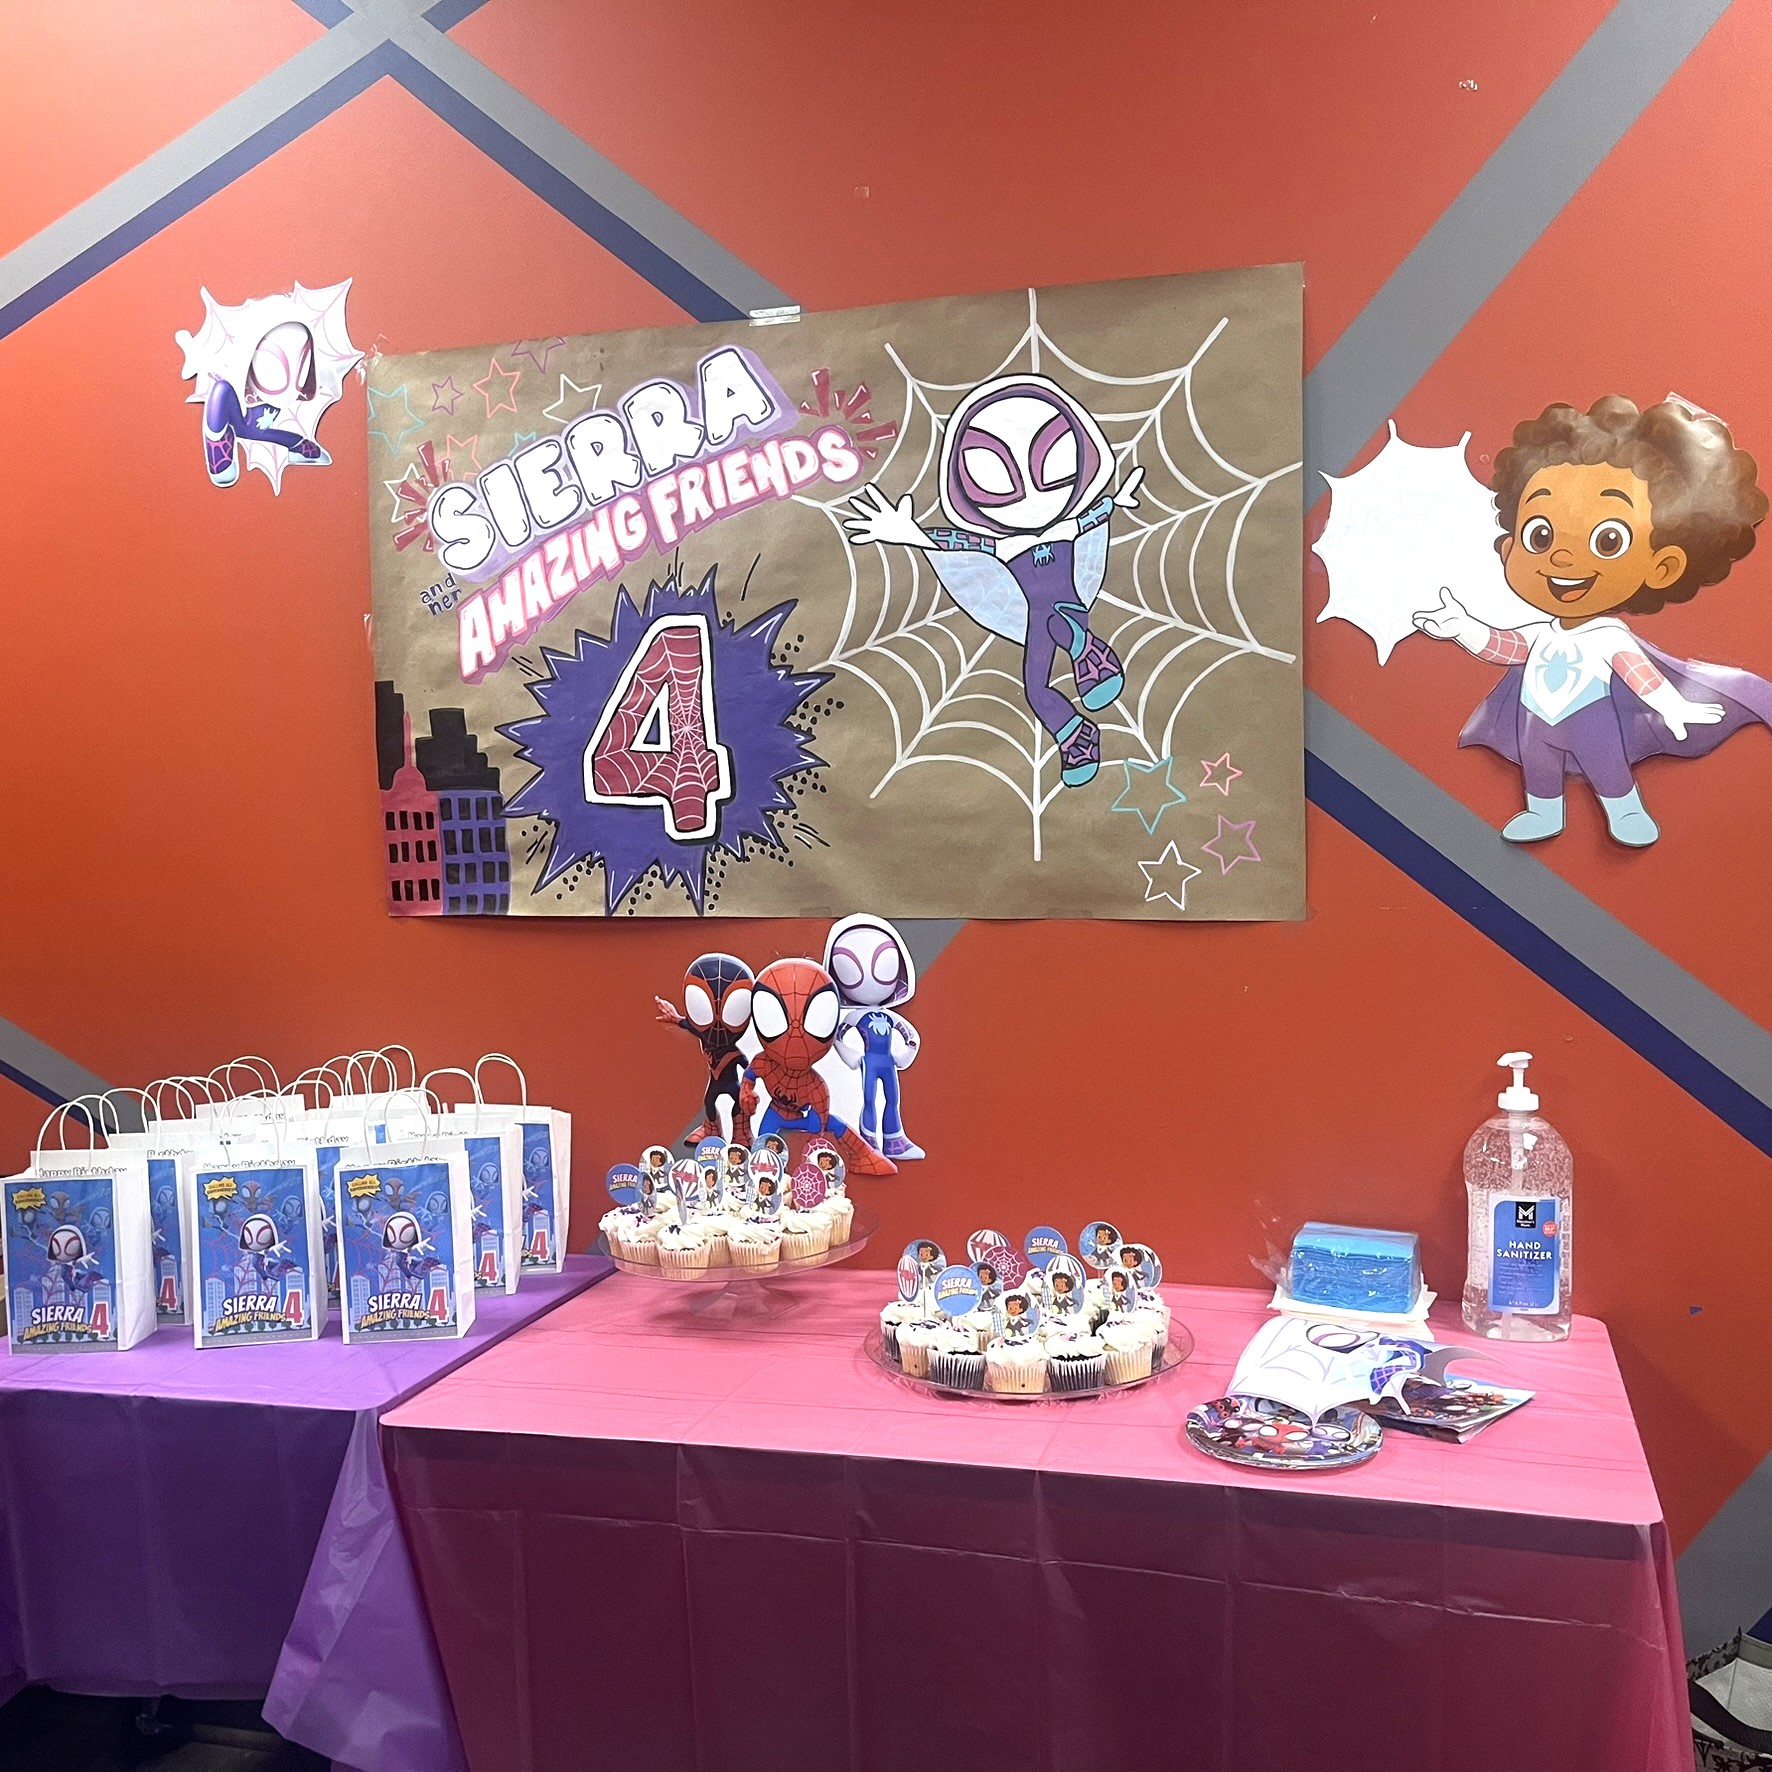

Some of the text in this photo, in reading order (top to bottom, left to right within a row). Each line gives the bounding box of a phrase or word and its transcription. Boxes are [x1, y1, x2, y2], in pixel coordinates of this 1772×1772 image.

[431, 347, 775, 571] SIERRA
[458, 431, 860, 680] AMAZING FRIENDS
[420, 572, 456, 604] and
[583, 613, 734, 842] 4
[612, 1173, 638, 1184] SIERRA
[529, 1230, 549, 1261] 4
[1031, 1237, 1059, 1249] SIERRA
[1496, 1248, 1553, 1260] SANITIZER
[1509, 1240, 1541, 1250] HAND
[479, 1250, 499, 1284] 4
[159, 1275, 177, 1311] 4
[941, 1277, 972, 1290] SIERRA
[223, 1294, 278, 1316] SIERRA
[283, 1289, 304, 1325] 4
[368, 1292, 422, 1313] SIERRA
[427, 1286, 449, 1322] 4
[31, 1304, 85, 1326] SIERRA
[90, 1301, 111, 1338] 4
[215, 1311, 253, 1333] AMAZING
[361, 1309, 397, 1328] AMAZING
[23, 1321, 60, 1340] AMAZING
